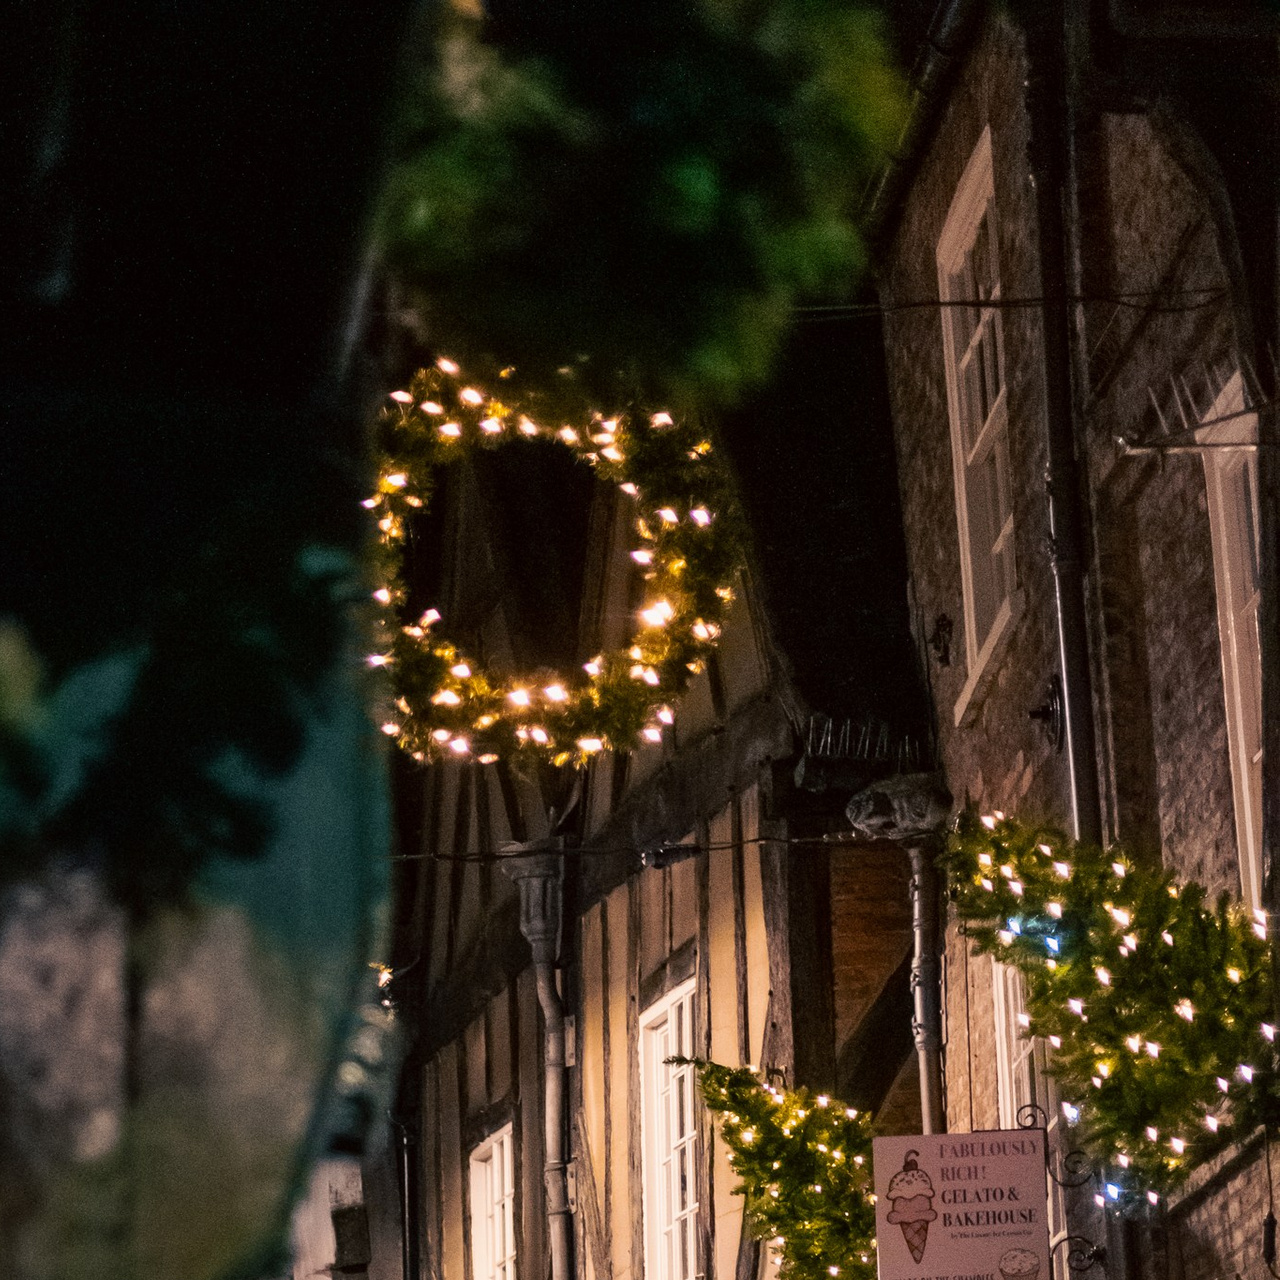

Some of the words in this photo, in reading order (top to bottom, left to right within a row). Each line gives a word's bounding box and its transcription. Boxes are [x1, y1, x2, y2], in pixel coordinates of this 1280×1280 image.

[940, 1141, 1037, 1158] FABULOUSLY
[941, 1187, 1004, 1204] GELATO
[1008, 1187, 1019, 1201] &
[942, 1208, 1037, 1227] BAKEHOUSE
